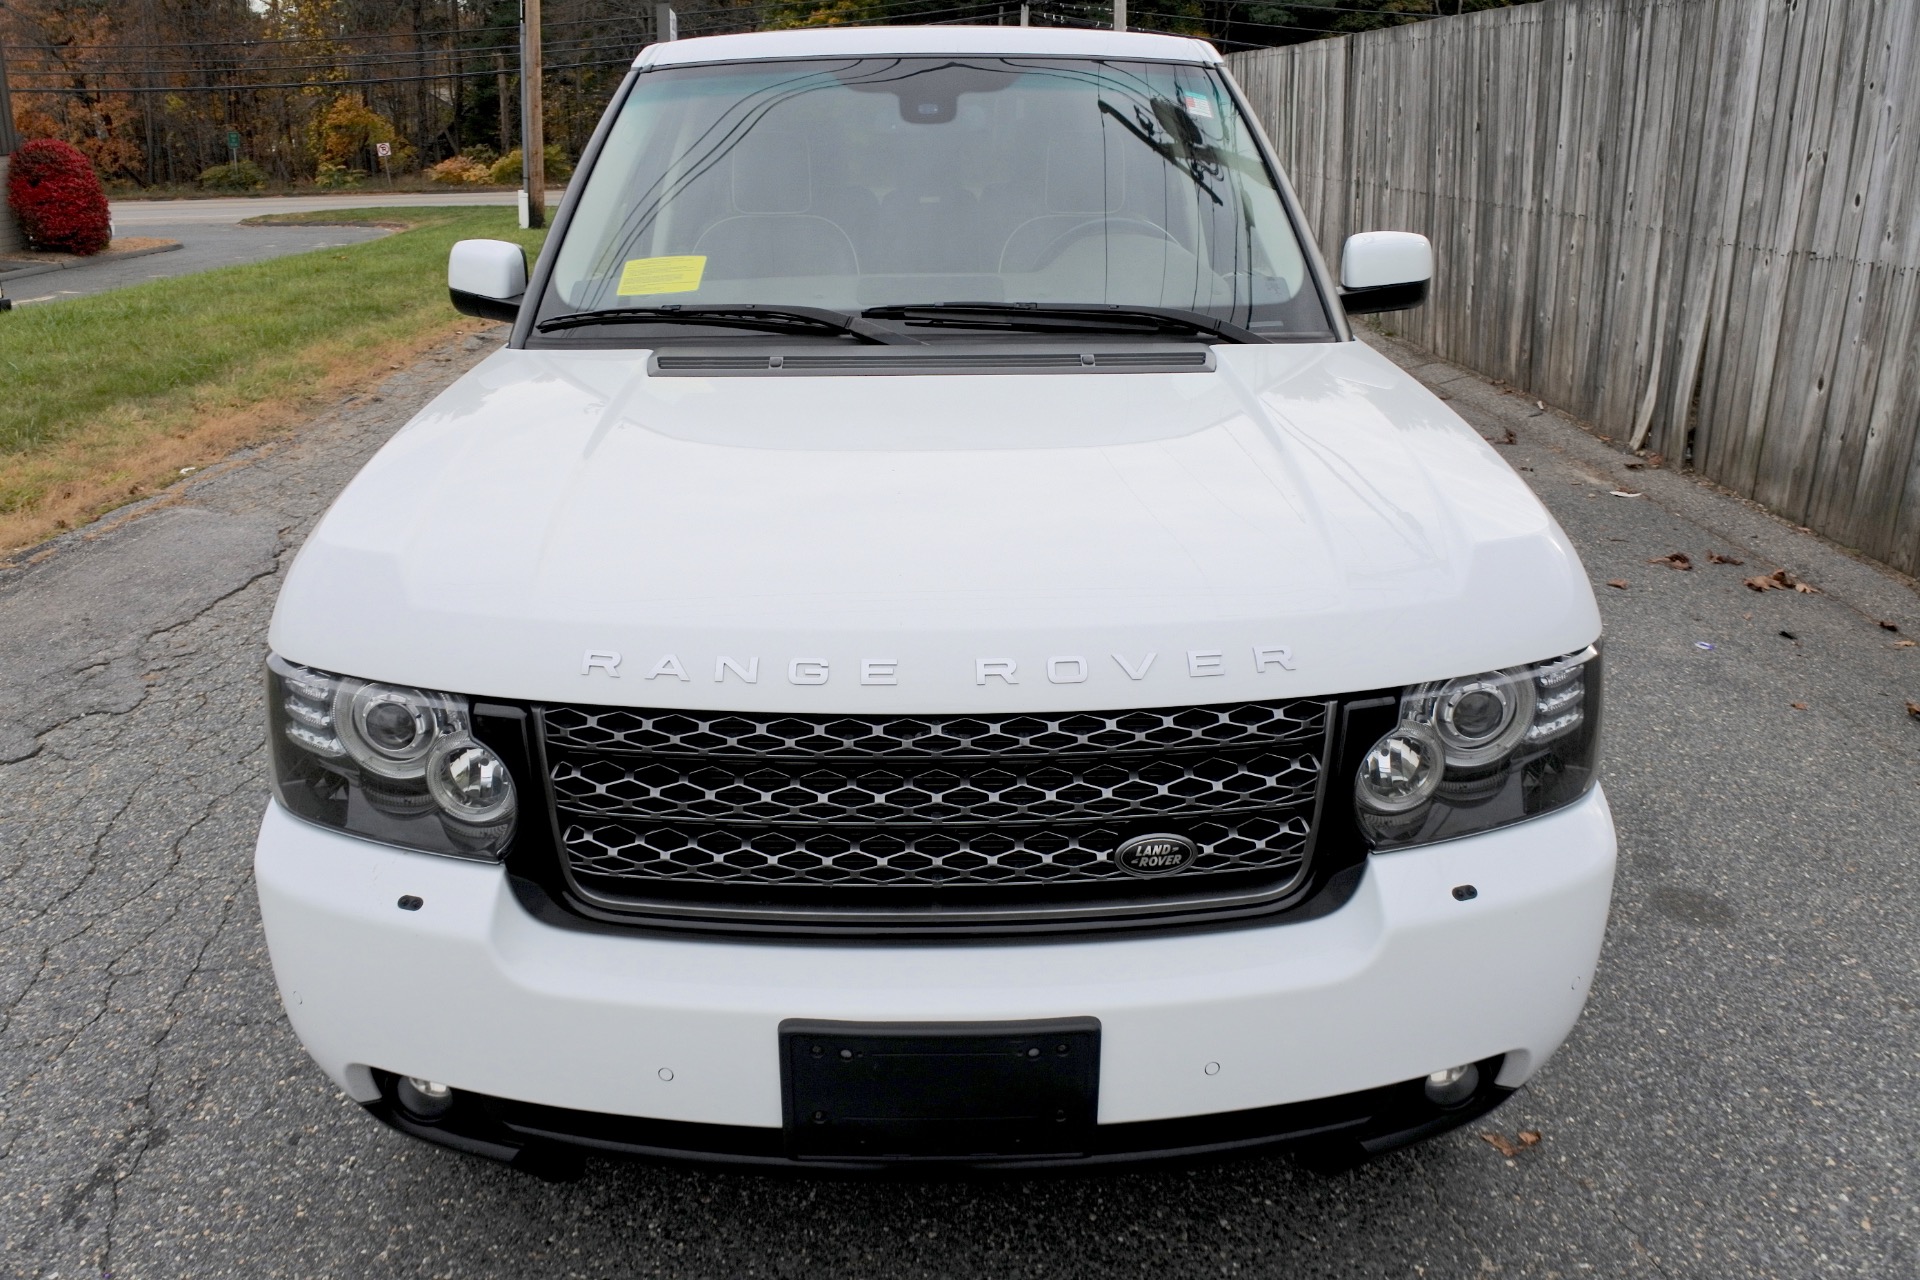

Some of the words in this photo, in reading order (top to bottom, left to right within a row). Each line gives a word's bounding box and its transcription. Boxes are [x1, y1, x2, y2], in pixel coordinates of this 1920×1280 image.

[580, 649, 898, 686] RANGE
[975, 644, 1297, 686] ROVER
[1135, 844, 1172, 857] LAND
[1138, 854, 1182, 867] ROVER
